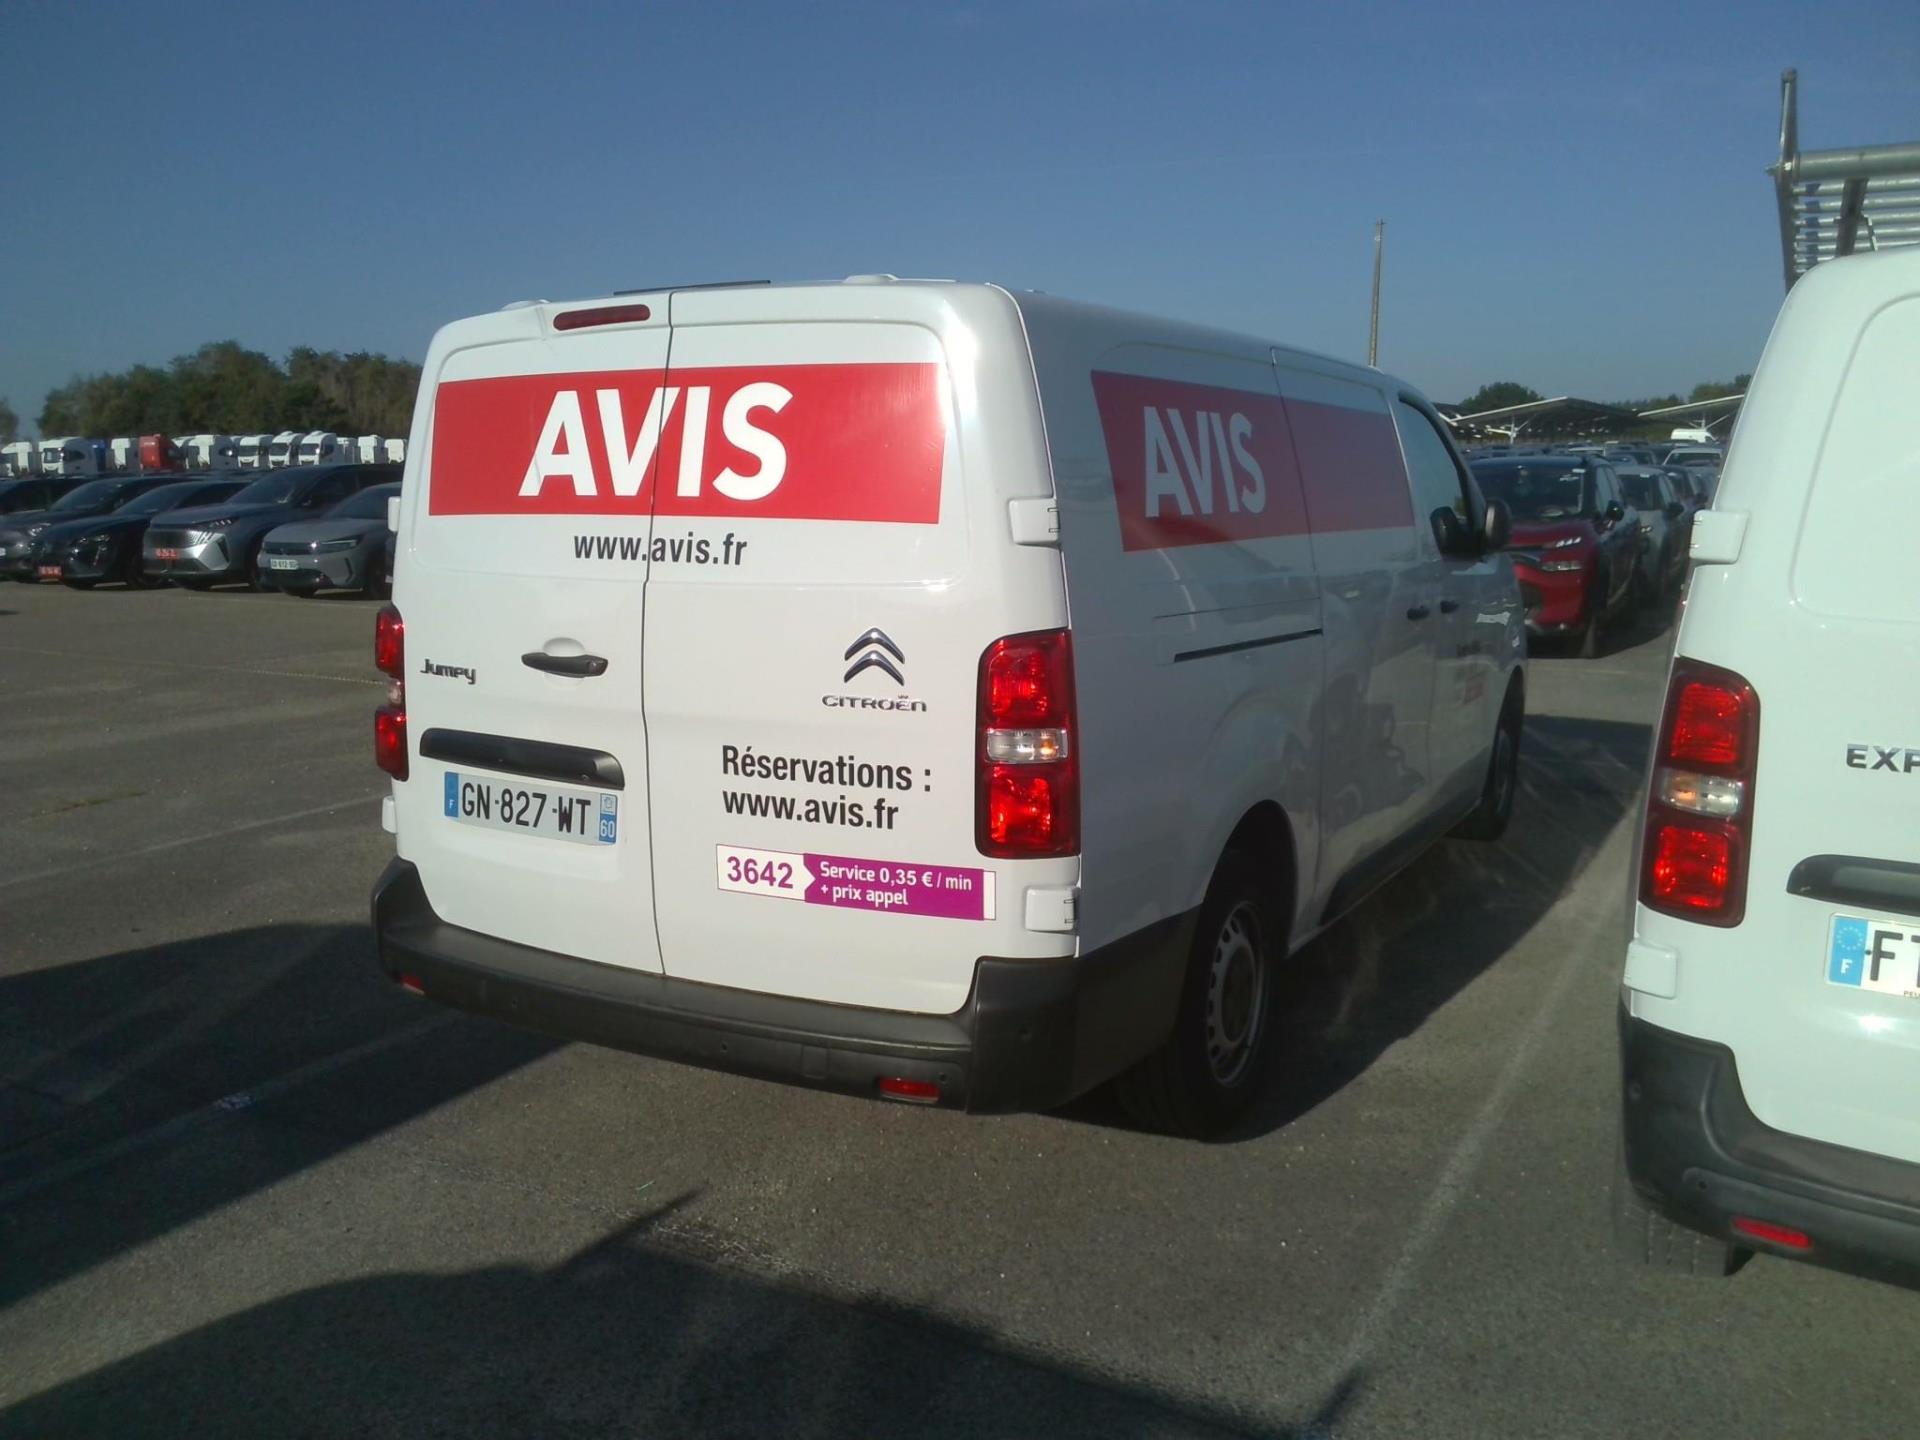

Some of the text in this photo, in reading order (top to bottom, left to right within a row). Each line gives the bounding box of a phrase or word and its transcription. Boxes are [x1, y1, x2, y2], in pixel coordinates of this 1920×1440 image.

[518, 381, 793, 501] AVIS
[1143, 405, 1266, 518] AVIS
[574, 531, 748, 566] www.avis.fr
[420, 658, 476, 685] Jumpy
[722, 745, 912, 791] Réservations
[461, 782, 591, 836] GN-827-WT
[722, 790, 899, 830] www.avis.fr
[600, 819, 616, 838] 60
[727, 856, 794, 890] 3642
[820, 861, 876, 883] Service
[879, 867, 917, 888] 0,35
[921, 871, 933, 888] €
[945, 873, 972, 891] min
[833, 884, 862, 903] prix
[866, 888, 909, 909] appel
[1841, 958, 1853, 974] F
